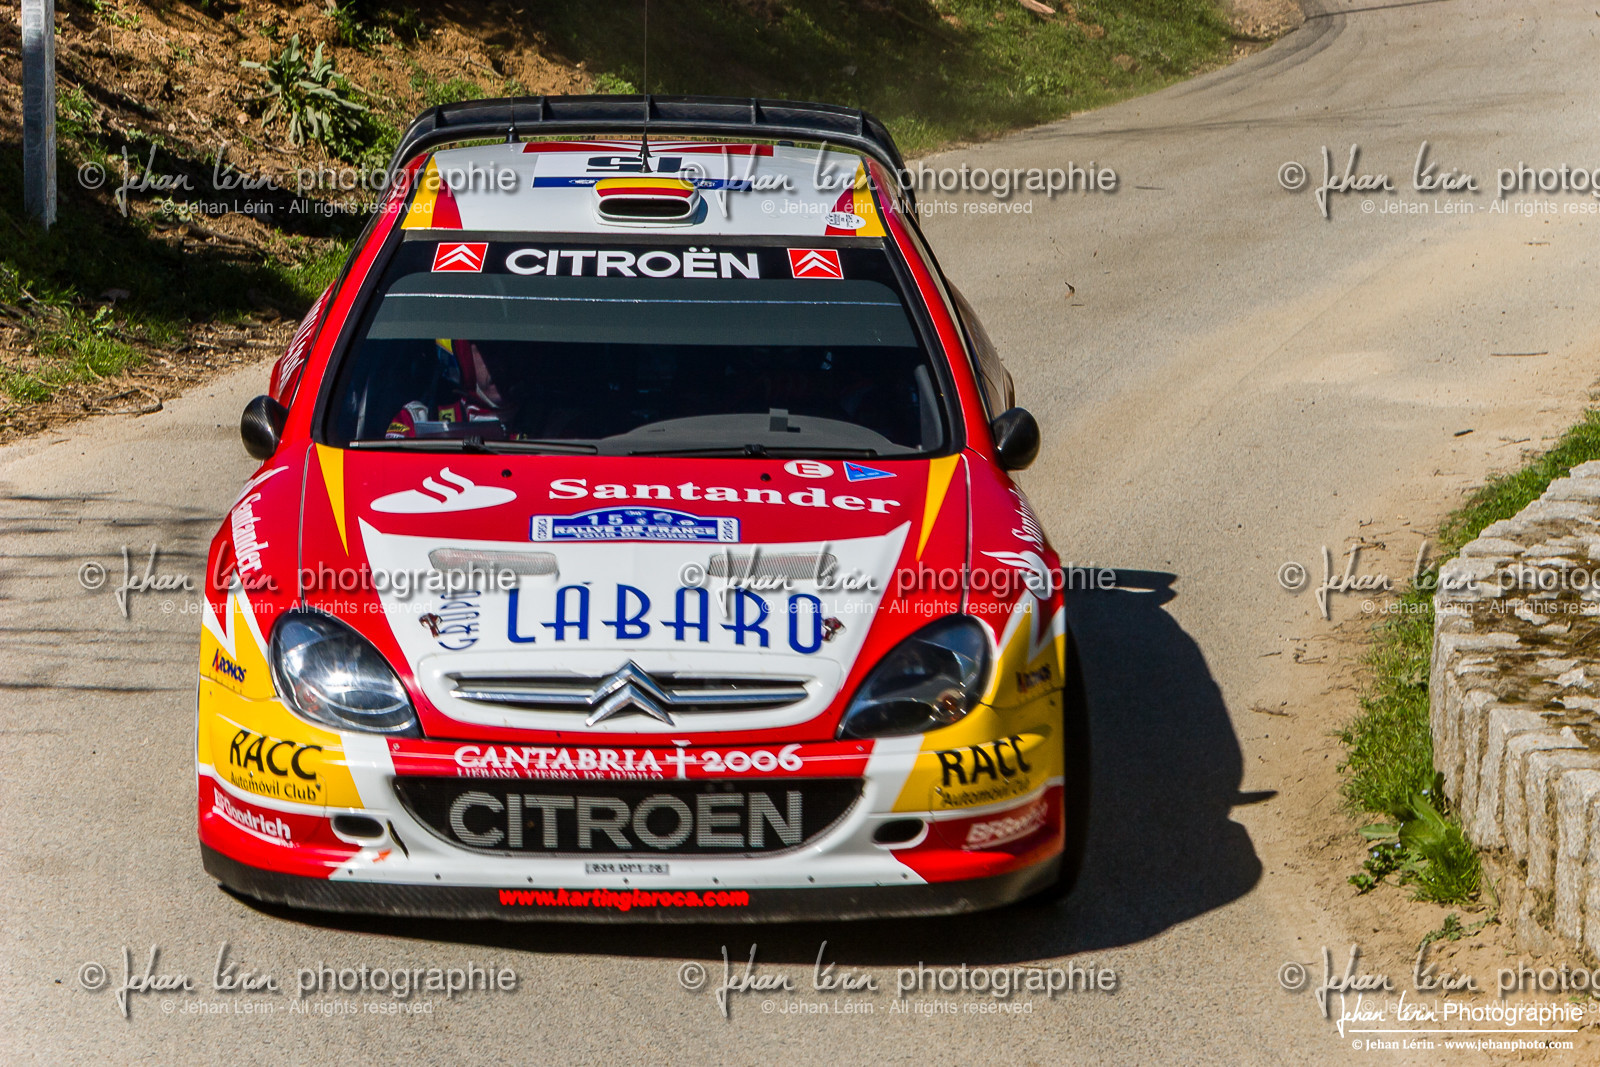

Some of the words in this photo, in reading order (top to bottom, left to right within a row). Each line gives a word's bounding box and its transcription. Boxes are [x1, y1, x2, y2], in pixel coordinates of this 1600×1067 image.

[505, 246, 760, 279] CITROËN
[549, 478, 901, 514] Santander
[230, 492, 270, 577] Santander
[554, 525, 617, 535] RALLYE
[620, 525, 645, 535] DE
[647, 525, 717, 536] FRANCE
[229, 729, 323, 781] RACC
[454, 745, 663, 772] CANTABRIA
[701, 743, 804, 773] 2006
[284, 783, 317, 801] Club
[499, 886, 750, 912] www.kartinglaroca.com
